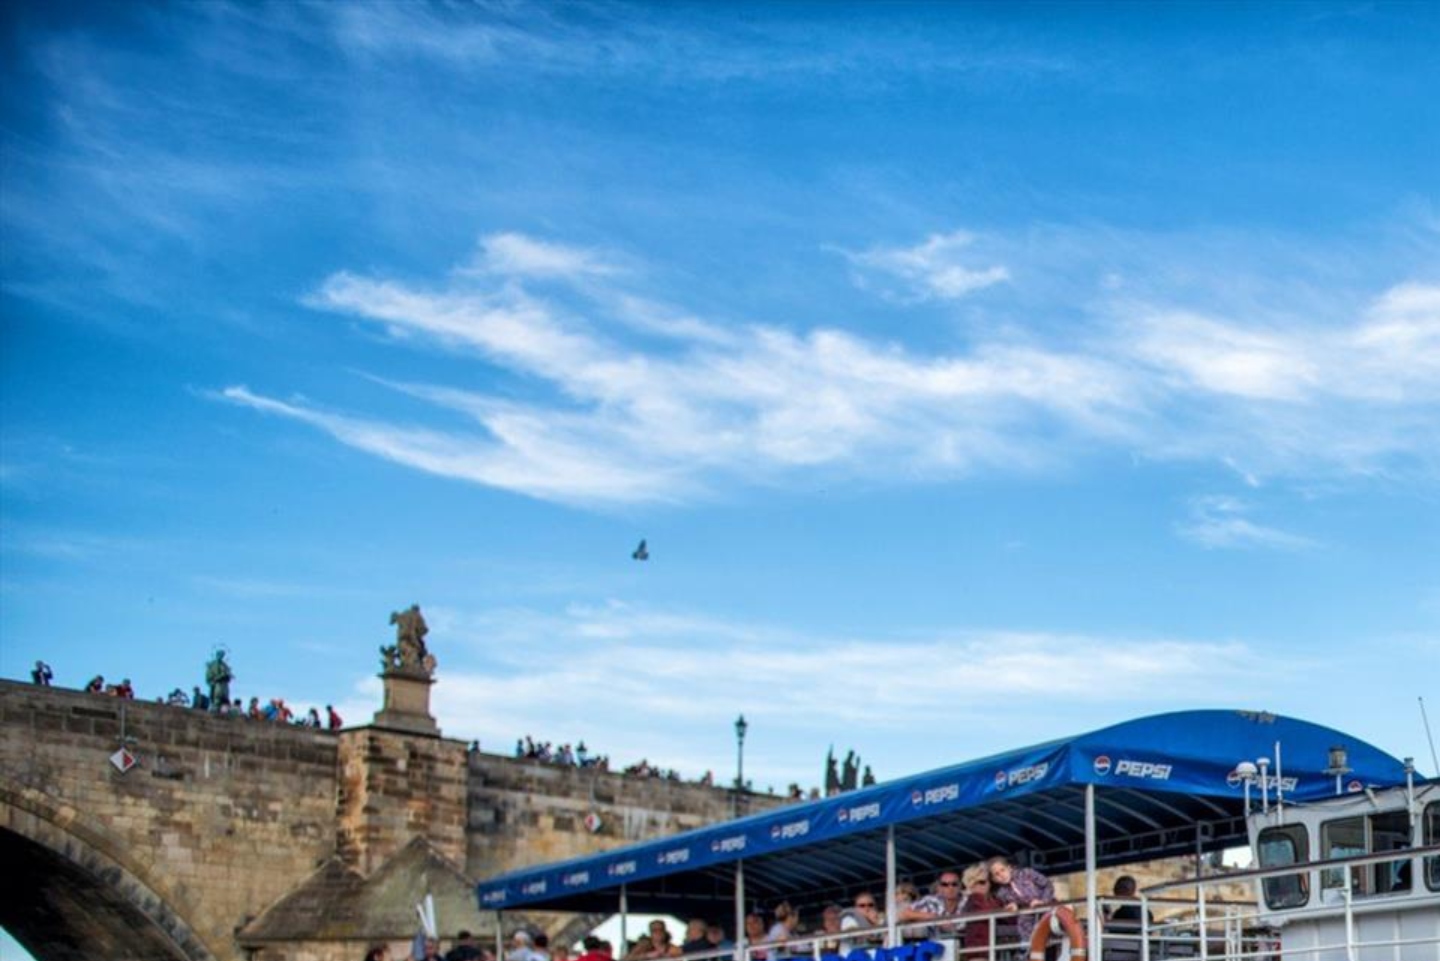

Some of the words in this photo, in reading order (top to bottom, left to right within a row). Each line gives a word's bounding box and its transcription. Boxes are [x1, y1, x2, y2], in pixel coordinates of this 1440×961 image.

[1008, 762, 1049, 786] PEPSI
[1114, 760, 1173, 780] PEPSI
[924, 784, 959, 805] PEPSI
[849, 803, 880, 822] PEPSI
